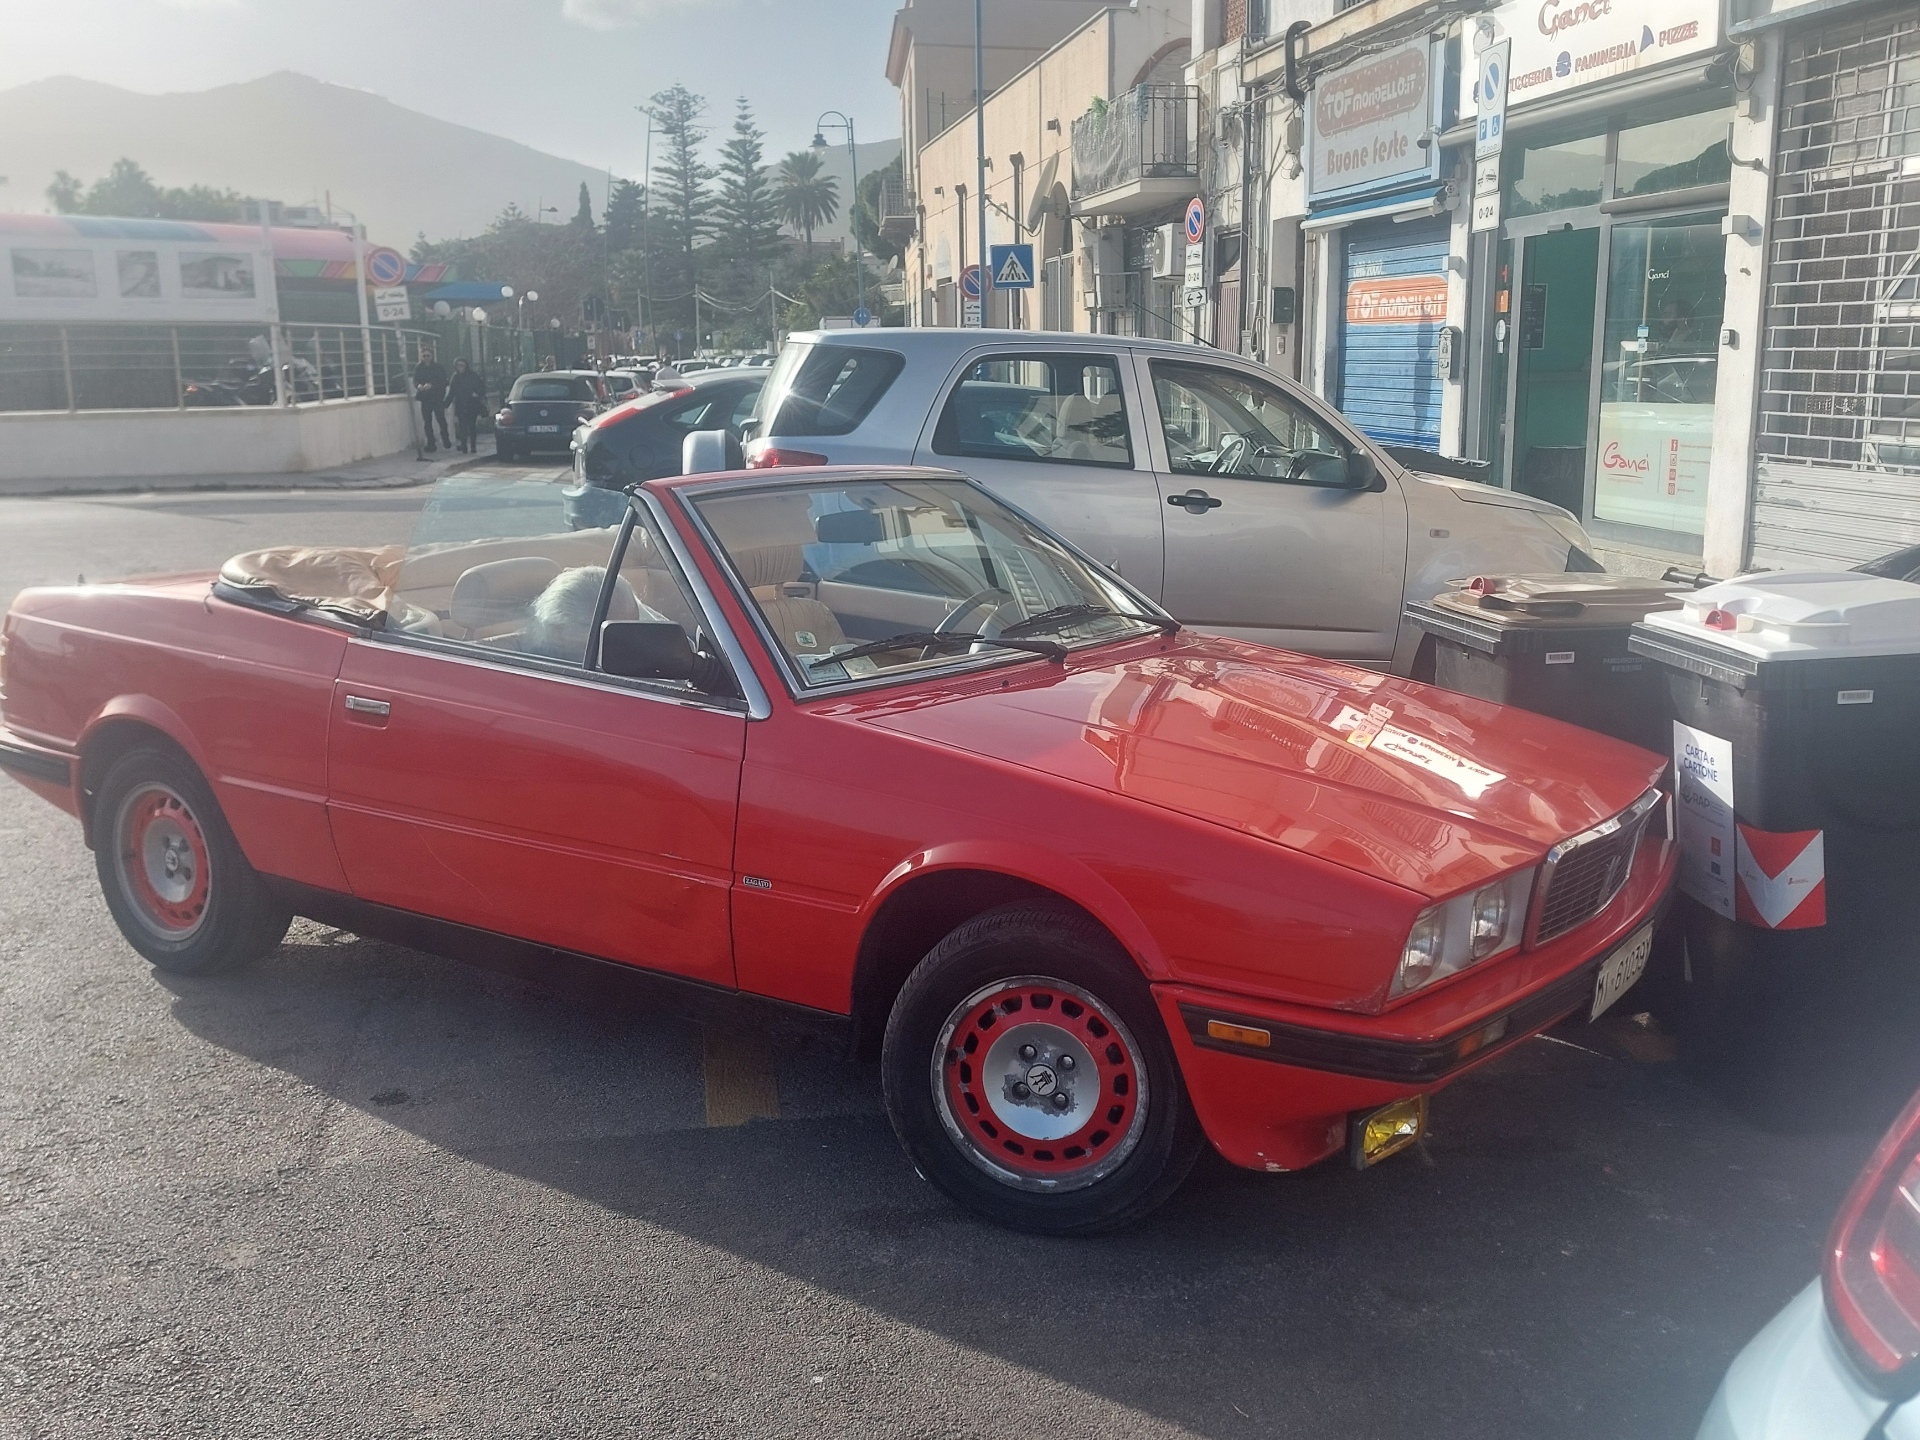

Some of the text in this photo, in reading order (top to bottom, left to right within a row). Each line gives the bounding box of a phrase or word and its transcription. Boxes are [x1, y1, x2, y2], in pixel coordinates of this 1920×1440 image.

[1574, 40, 1636, 73] PANINERIA
[1327, 146, 1368, 176] Buone
[1478, 205, 1494, 220] 0-24
[1603, 442, 1650, 472] Ganci
[1685, 743, 1710, 764] CARTA
[1683, 757, 1718, 783] CARTONE
